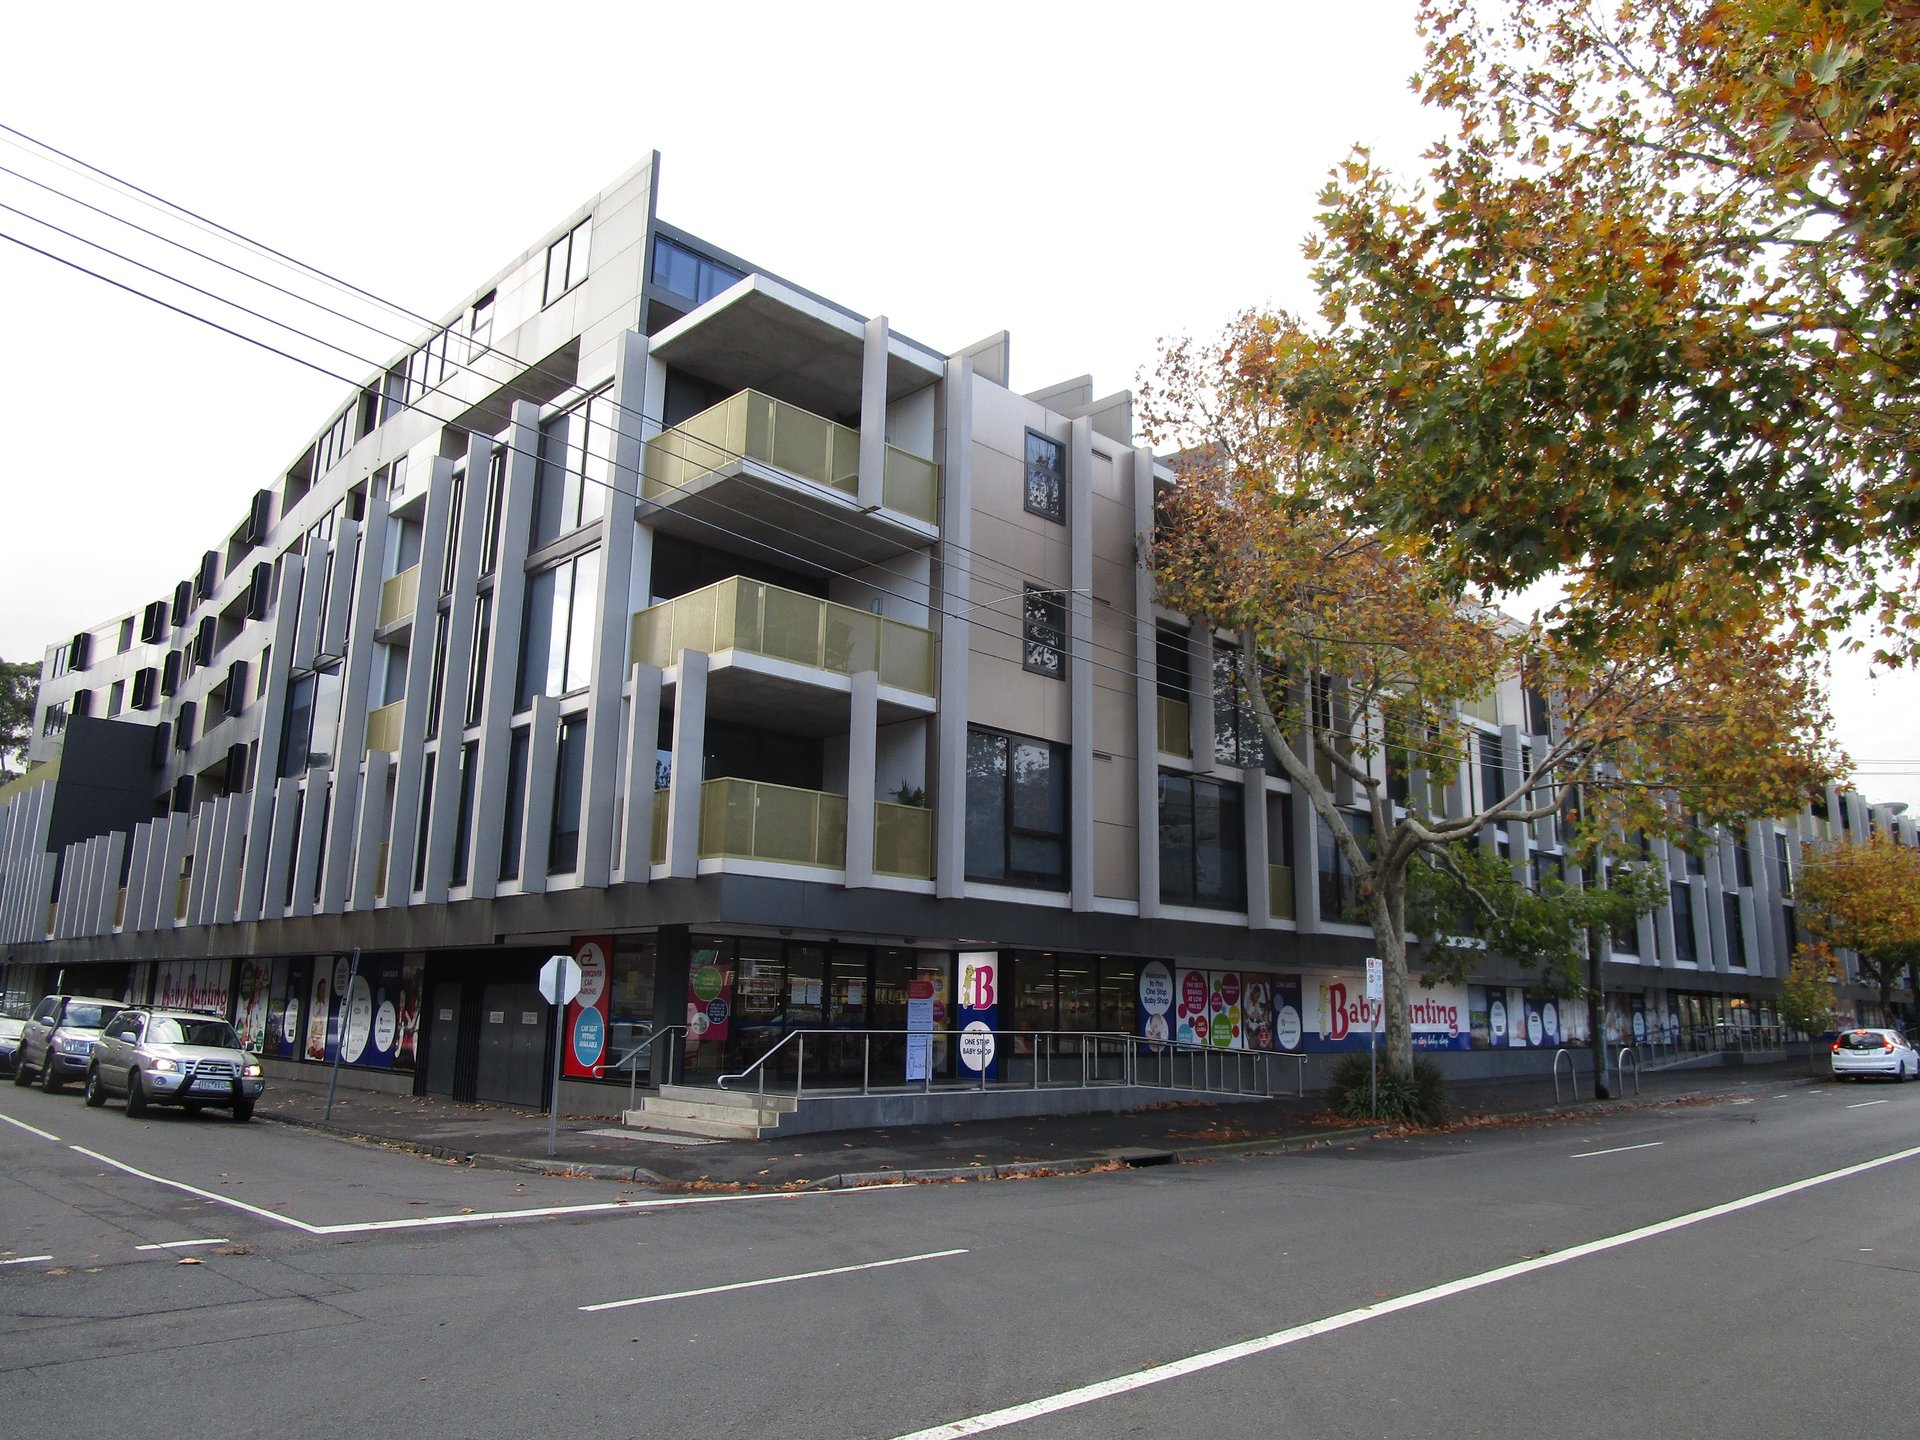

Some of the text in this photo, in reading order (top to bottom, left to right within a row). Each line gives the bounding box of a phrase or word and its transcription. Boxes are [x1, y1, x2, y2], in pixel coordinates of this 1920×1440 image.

[1145, 971, 1167, 979] Welcome
[974, 966, 994, 1010] B
[1146, 987, 1167, 996] One Stop
[1144, 997, 1169, 1006] Baby Shop
[1329, 983, 1459, 1040] Baby nting
